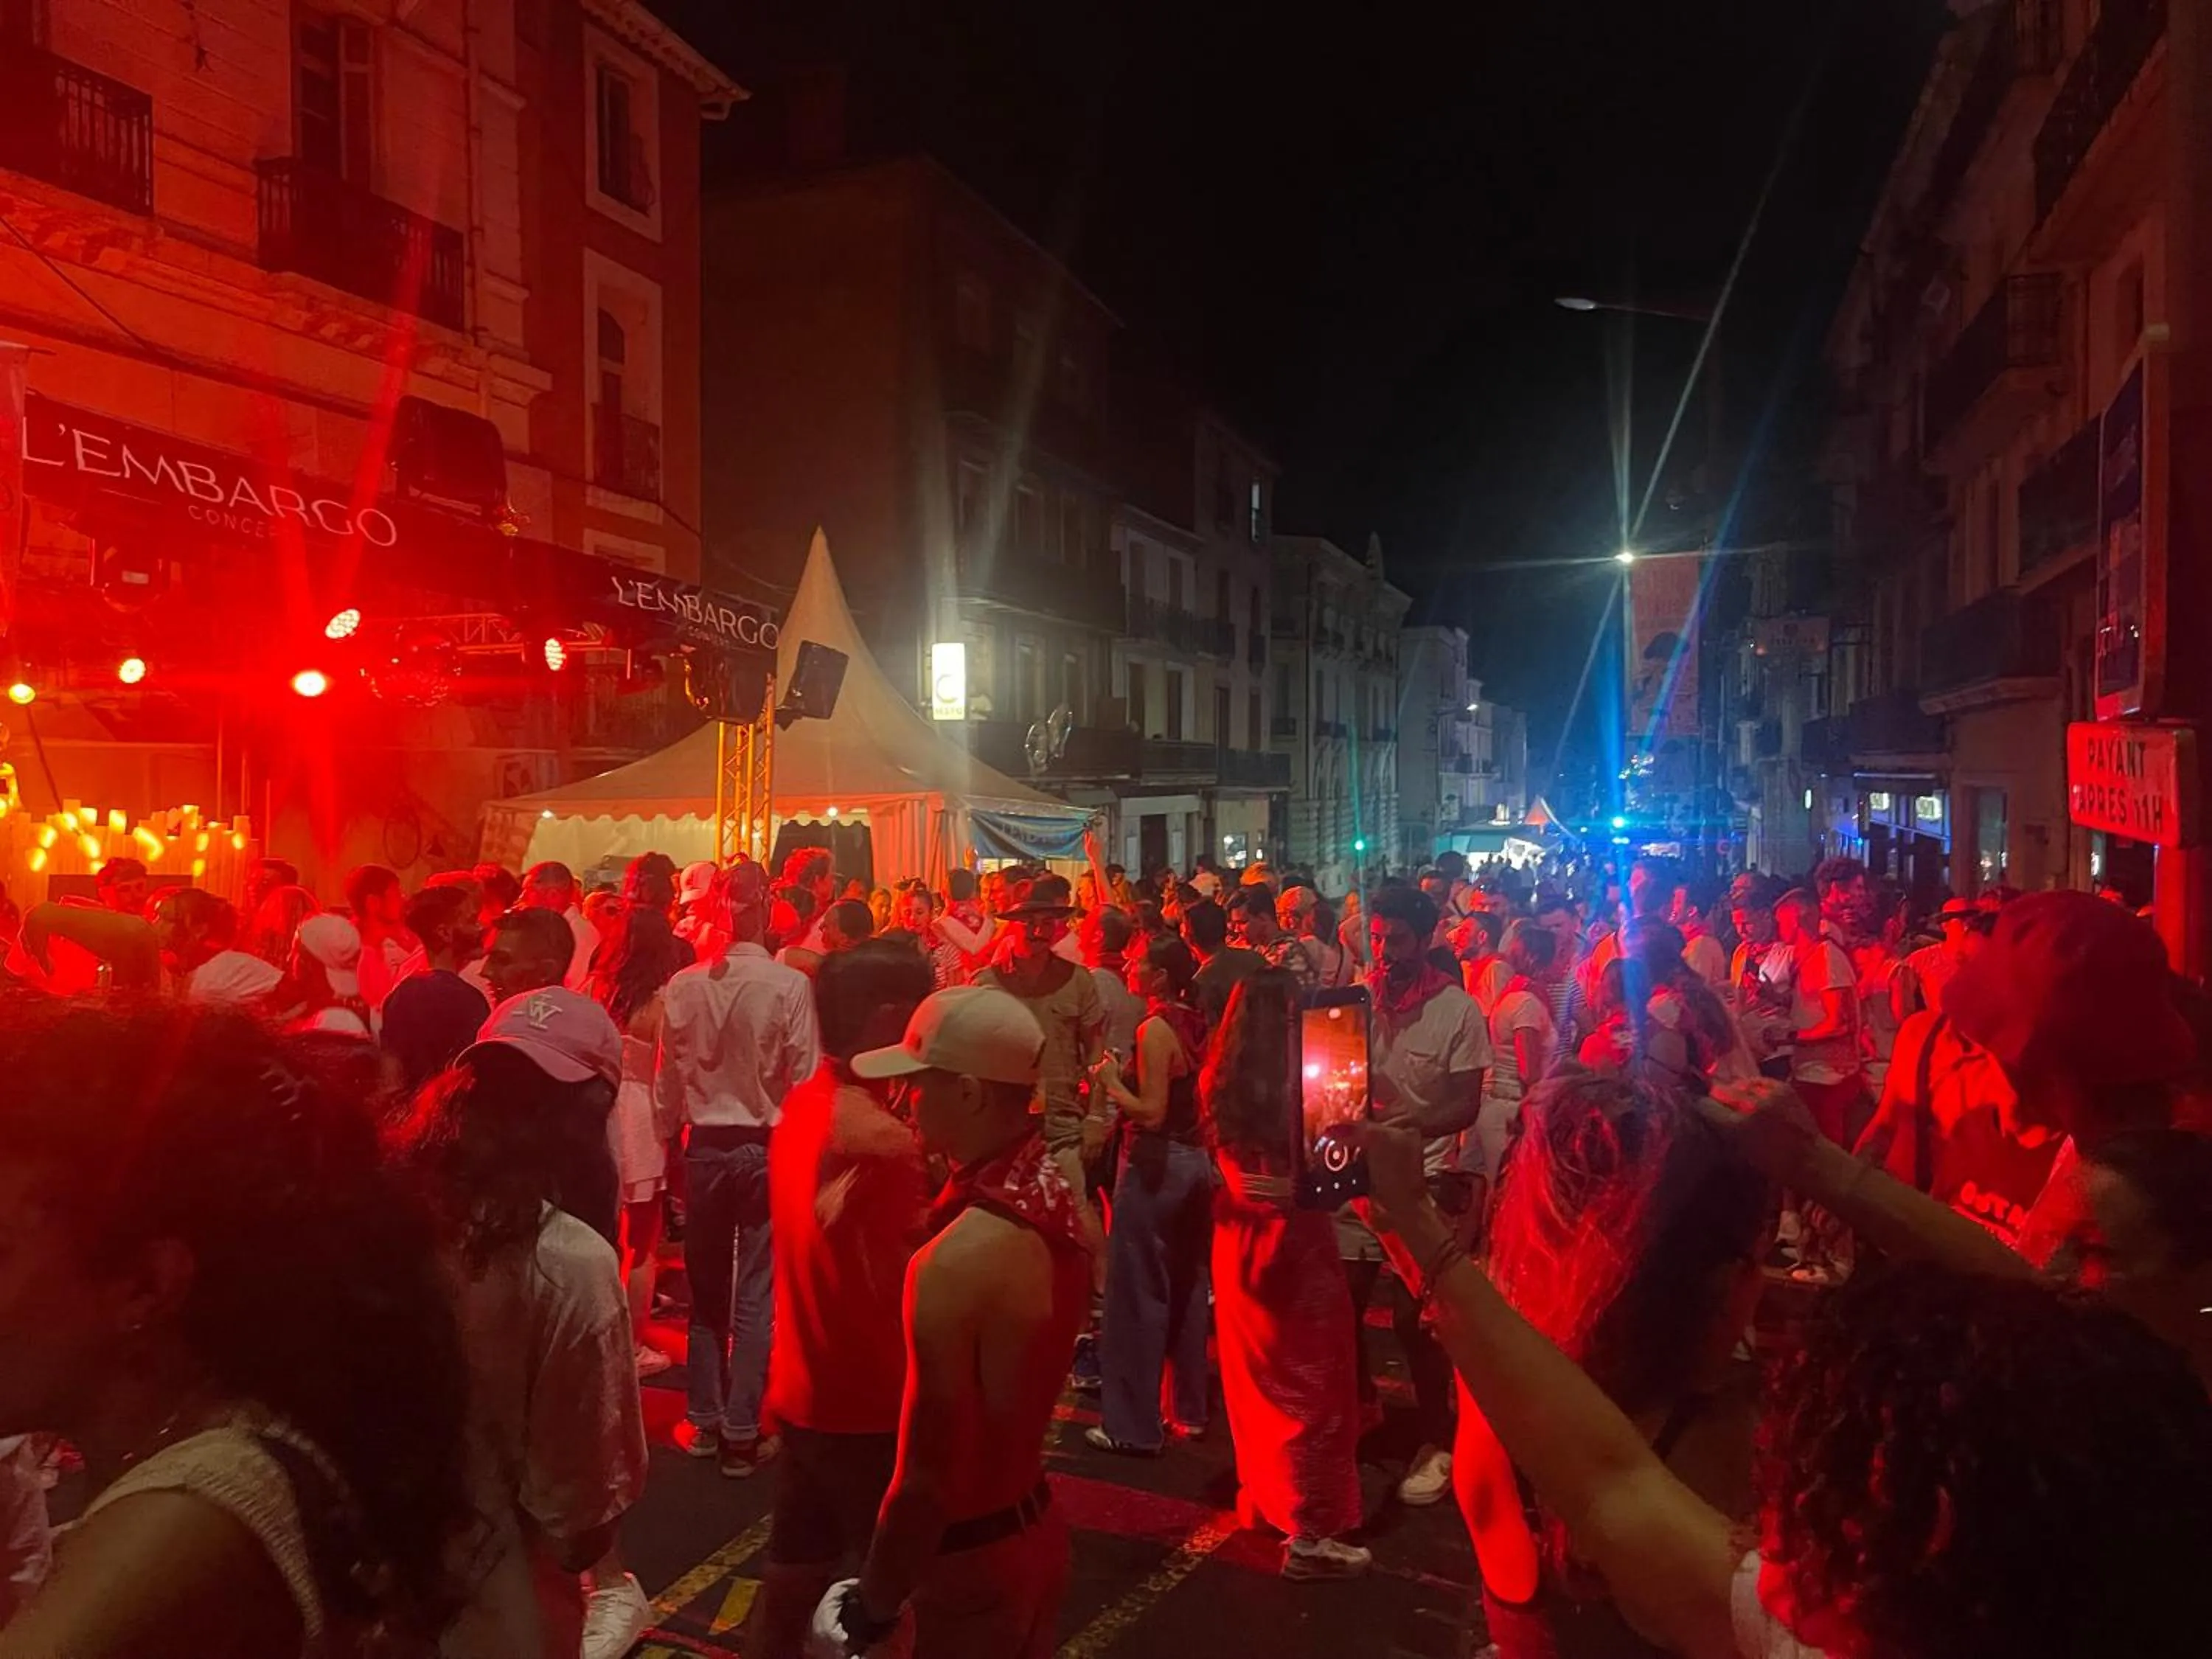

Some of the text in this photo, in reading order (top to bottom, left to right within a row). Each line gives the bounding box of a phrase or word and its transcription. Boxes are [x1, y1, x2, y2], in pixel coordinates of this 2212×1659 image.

[21, 416, 397, 547] L'EMBARGO
[610, 574, 779, 650] L'EMBARGO
[2087, 736, 2146, 779] PAYANT
[2133, 793, 2163, 836] 11H
